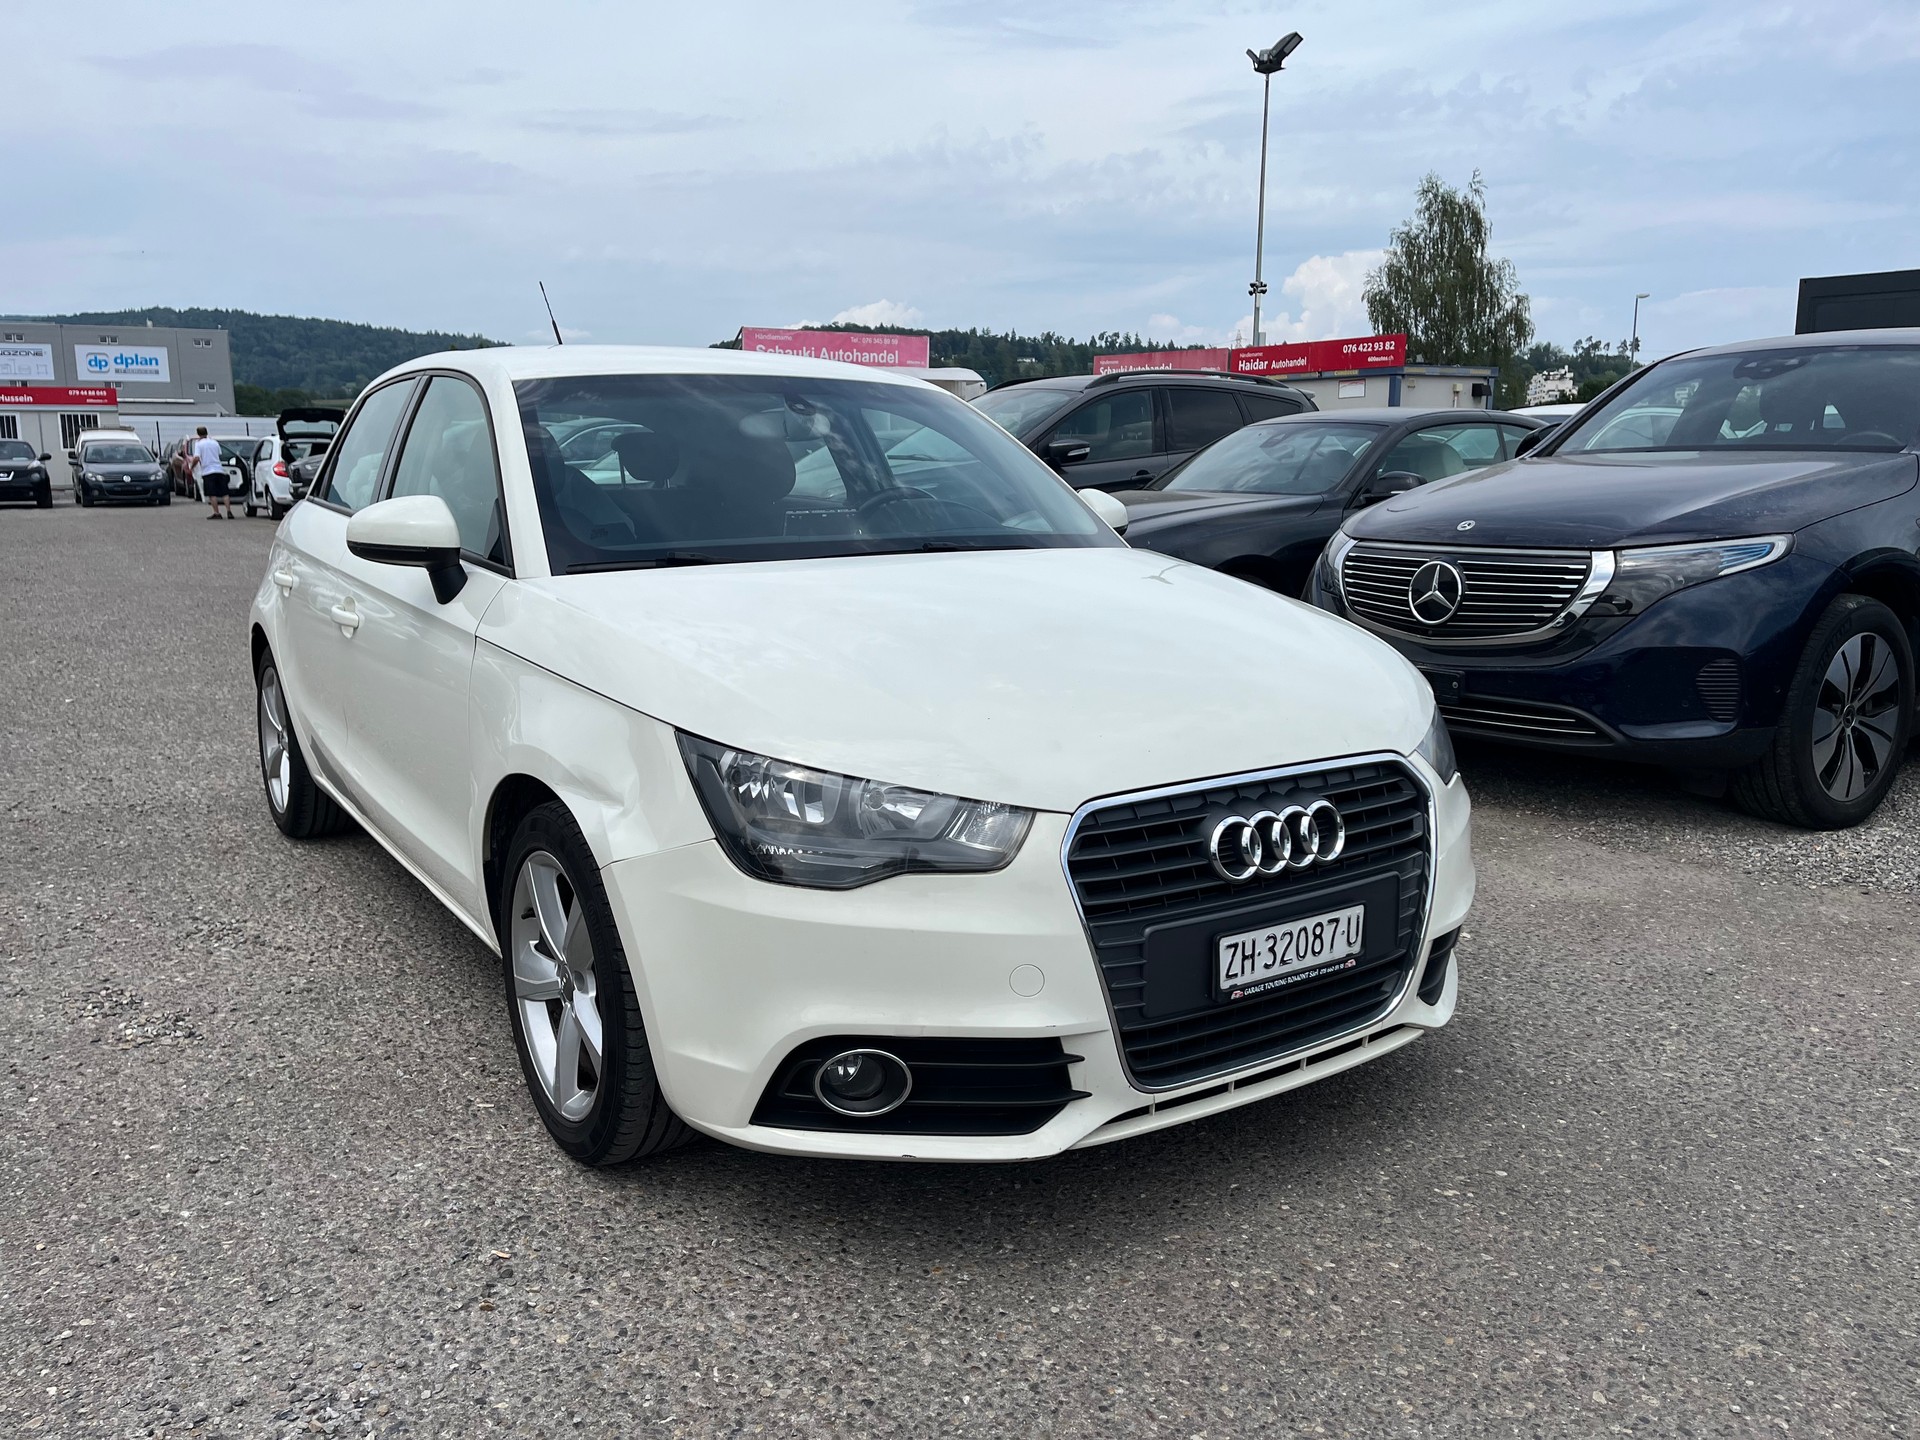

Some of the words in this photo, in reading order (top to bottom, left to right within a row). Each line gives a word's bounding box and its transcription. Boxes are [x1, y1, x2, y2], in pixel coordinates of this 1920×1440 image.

[1342, 343, 1357, 353] 076
[1357, 342, 1373, 352] 422
[1373, 341, 1384, 351] 93
[1385, 340, 1395, 350] 82
[88, 354, 108, 370] dp
[113, 353, 159, 368] dplan
[820, 346, 899, 364] Autohandel
[1238, 358, 1269, 371] Haidar
[1270, 356, 1307, 369] Autohandel
[1244, 983, 1264, 995] GARAGE
